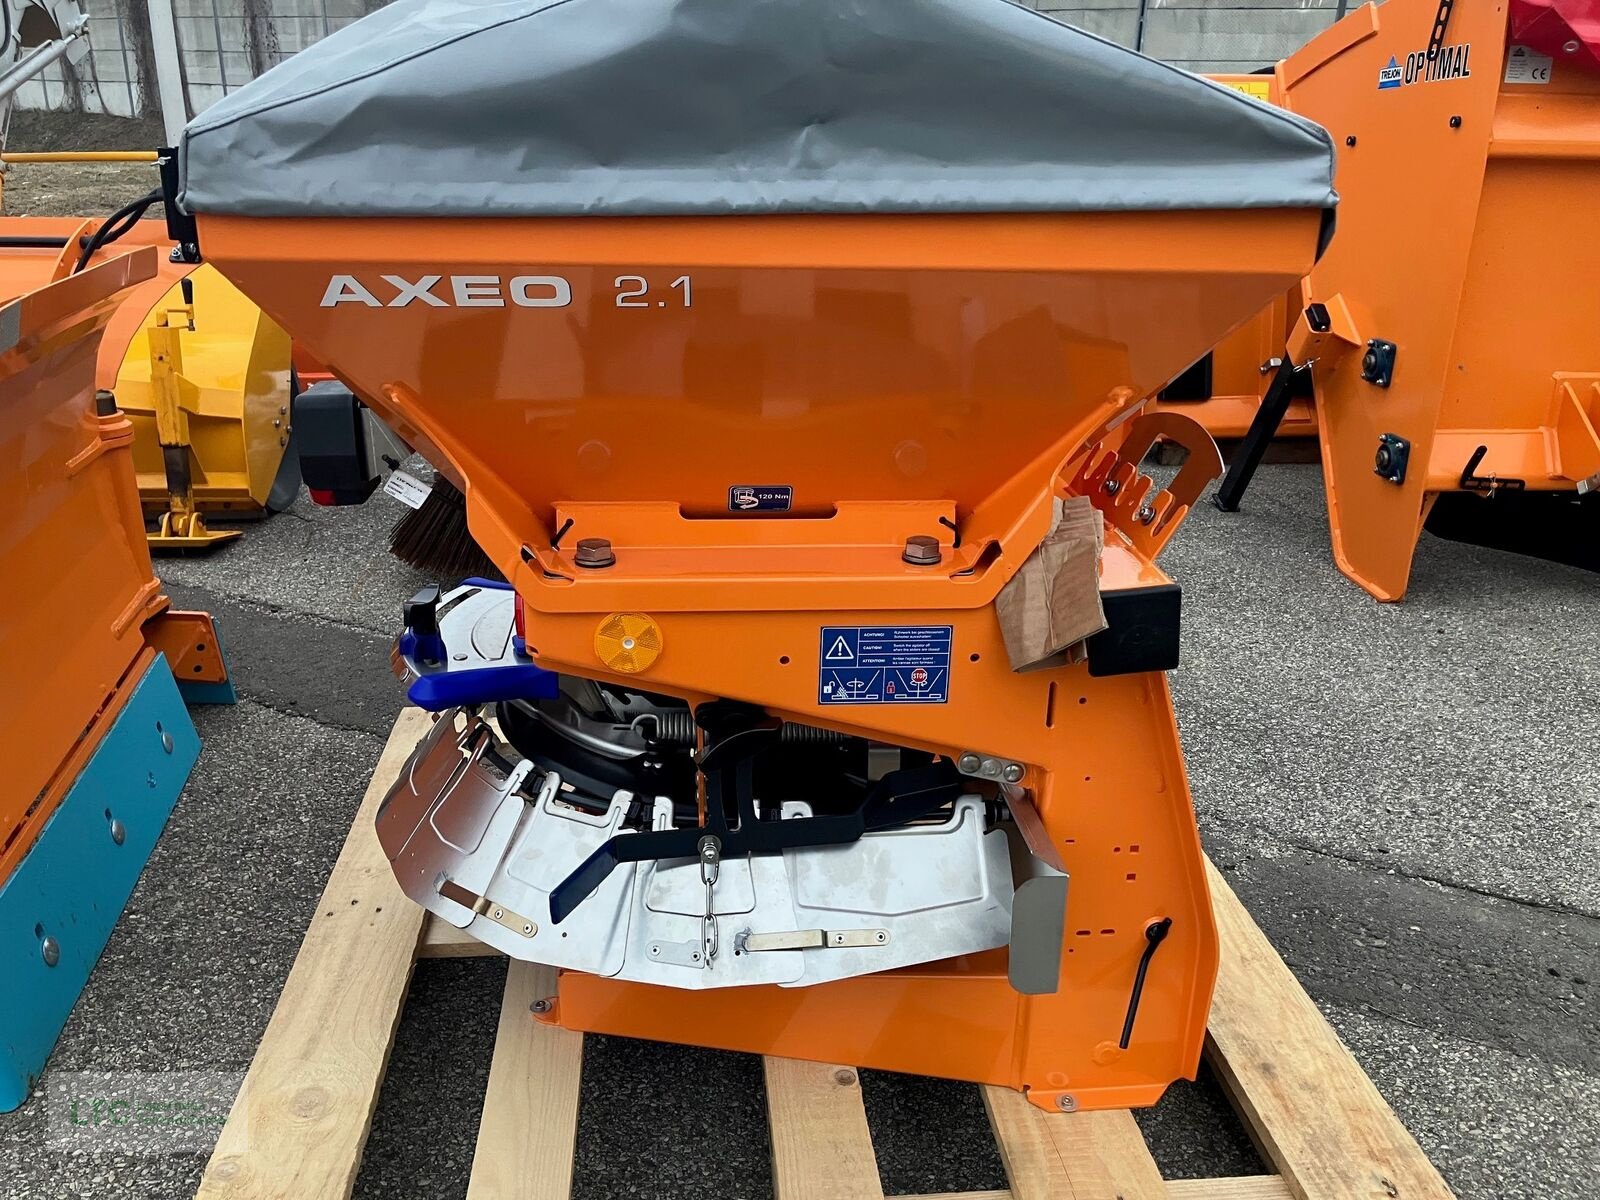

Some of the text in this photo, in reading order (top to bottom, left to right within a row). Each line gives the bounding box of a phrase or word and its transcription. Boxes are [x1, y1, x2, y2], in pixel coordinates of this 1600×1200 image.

[1381, 68, 1402, 80] TREJON
[319, 274, 693, 308] AXEO 2.1
